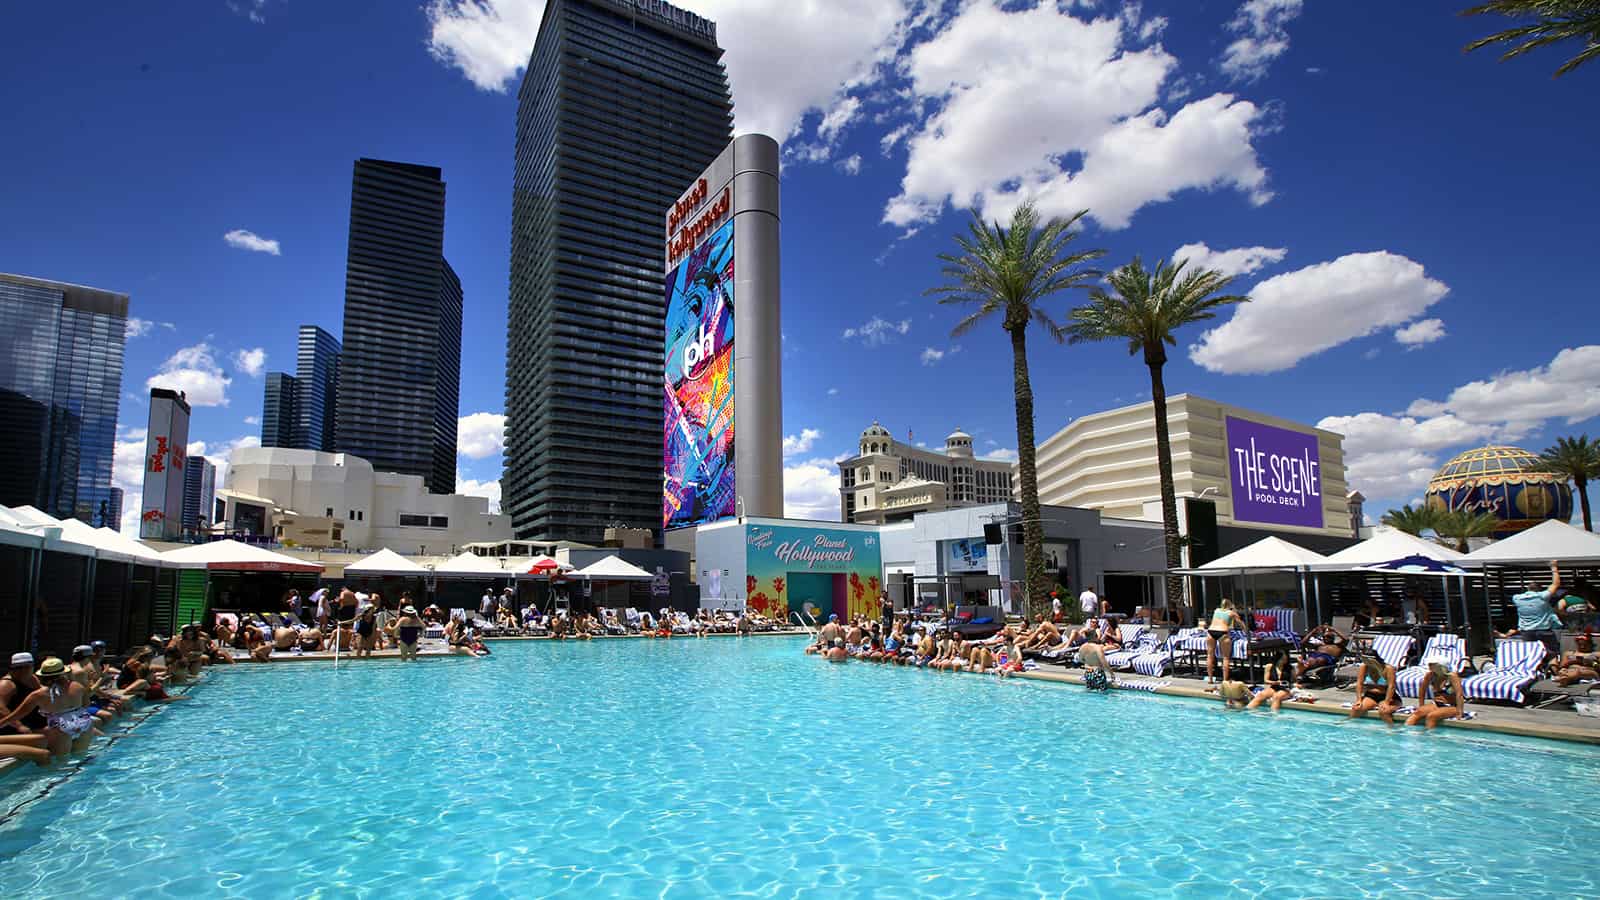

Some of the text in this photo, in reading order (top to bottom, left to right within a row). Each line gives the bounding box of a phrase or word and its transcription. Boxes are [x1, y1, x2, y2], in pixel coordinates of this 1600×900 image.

[684, 322, 715, 379] ph
[1234, 437, 1320, 508] THE SCENE
[1255, 493, 1300, 507] POOL DECK
[775, 539, 855, 568] Hollywood
[814, 534, 848, 549] Planet
